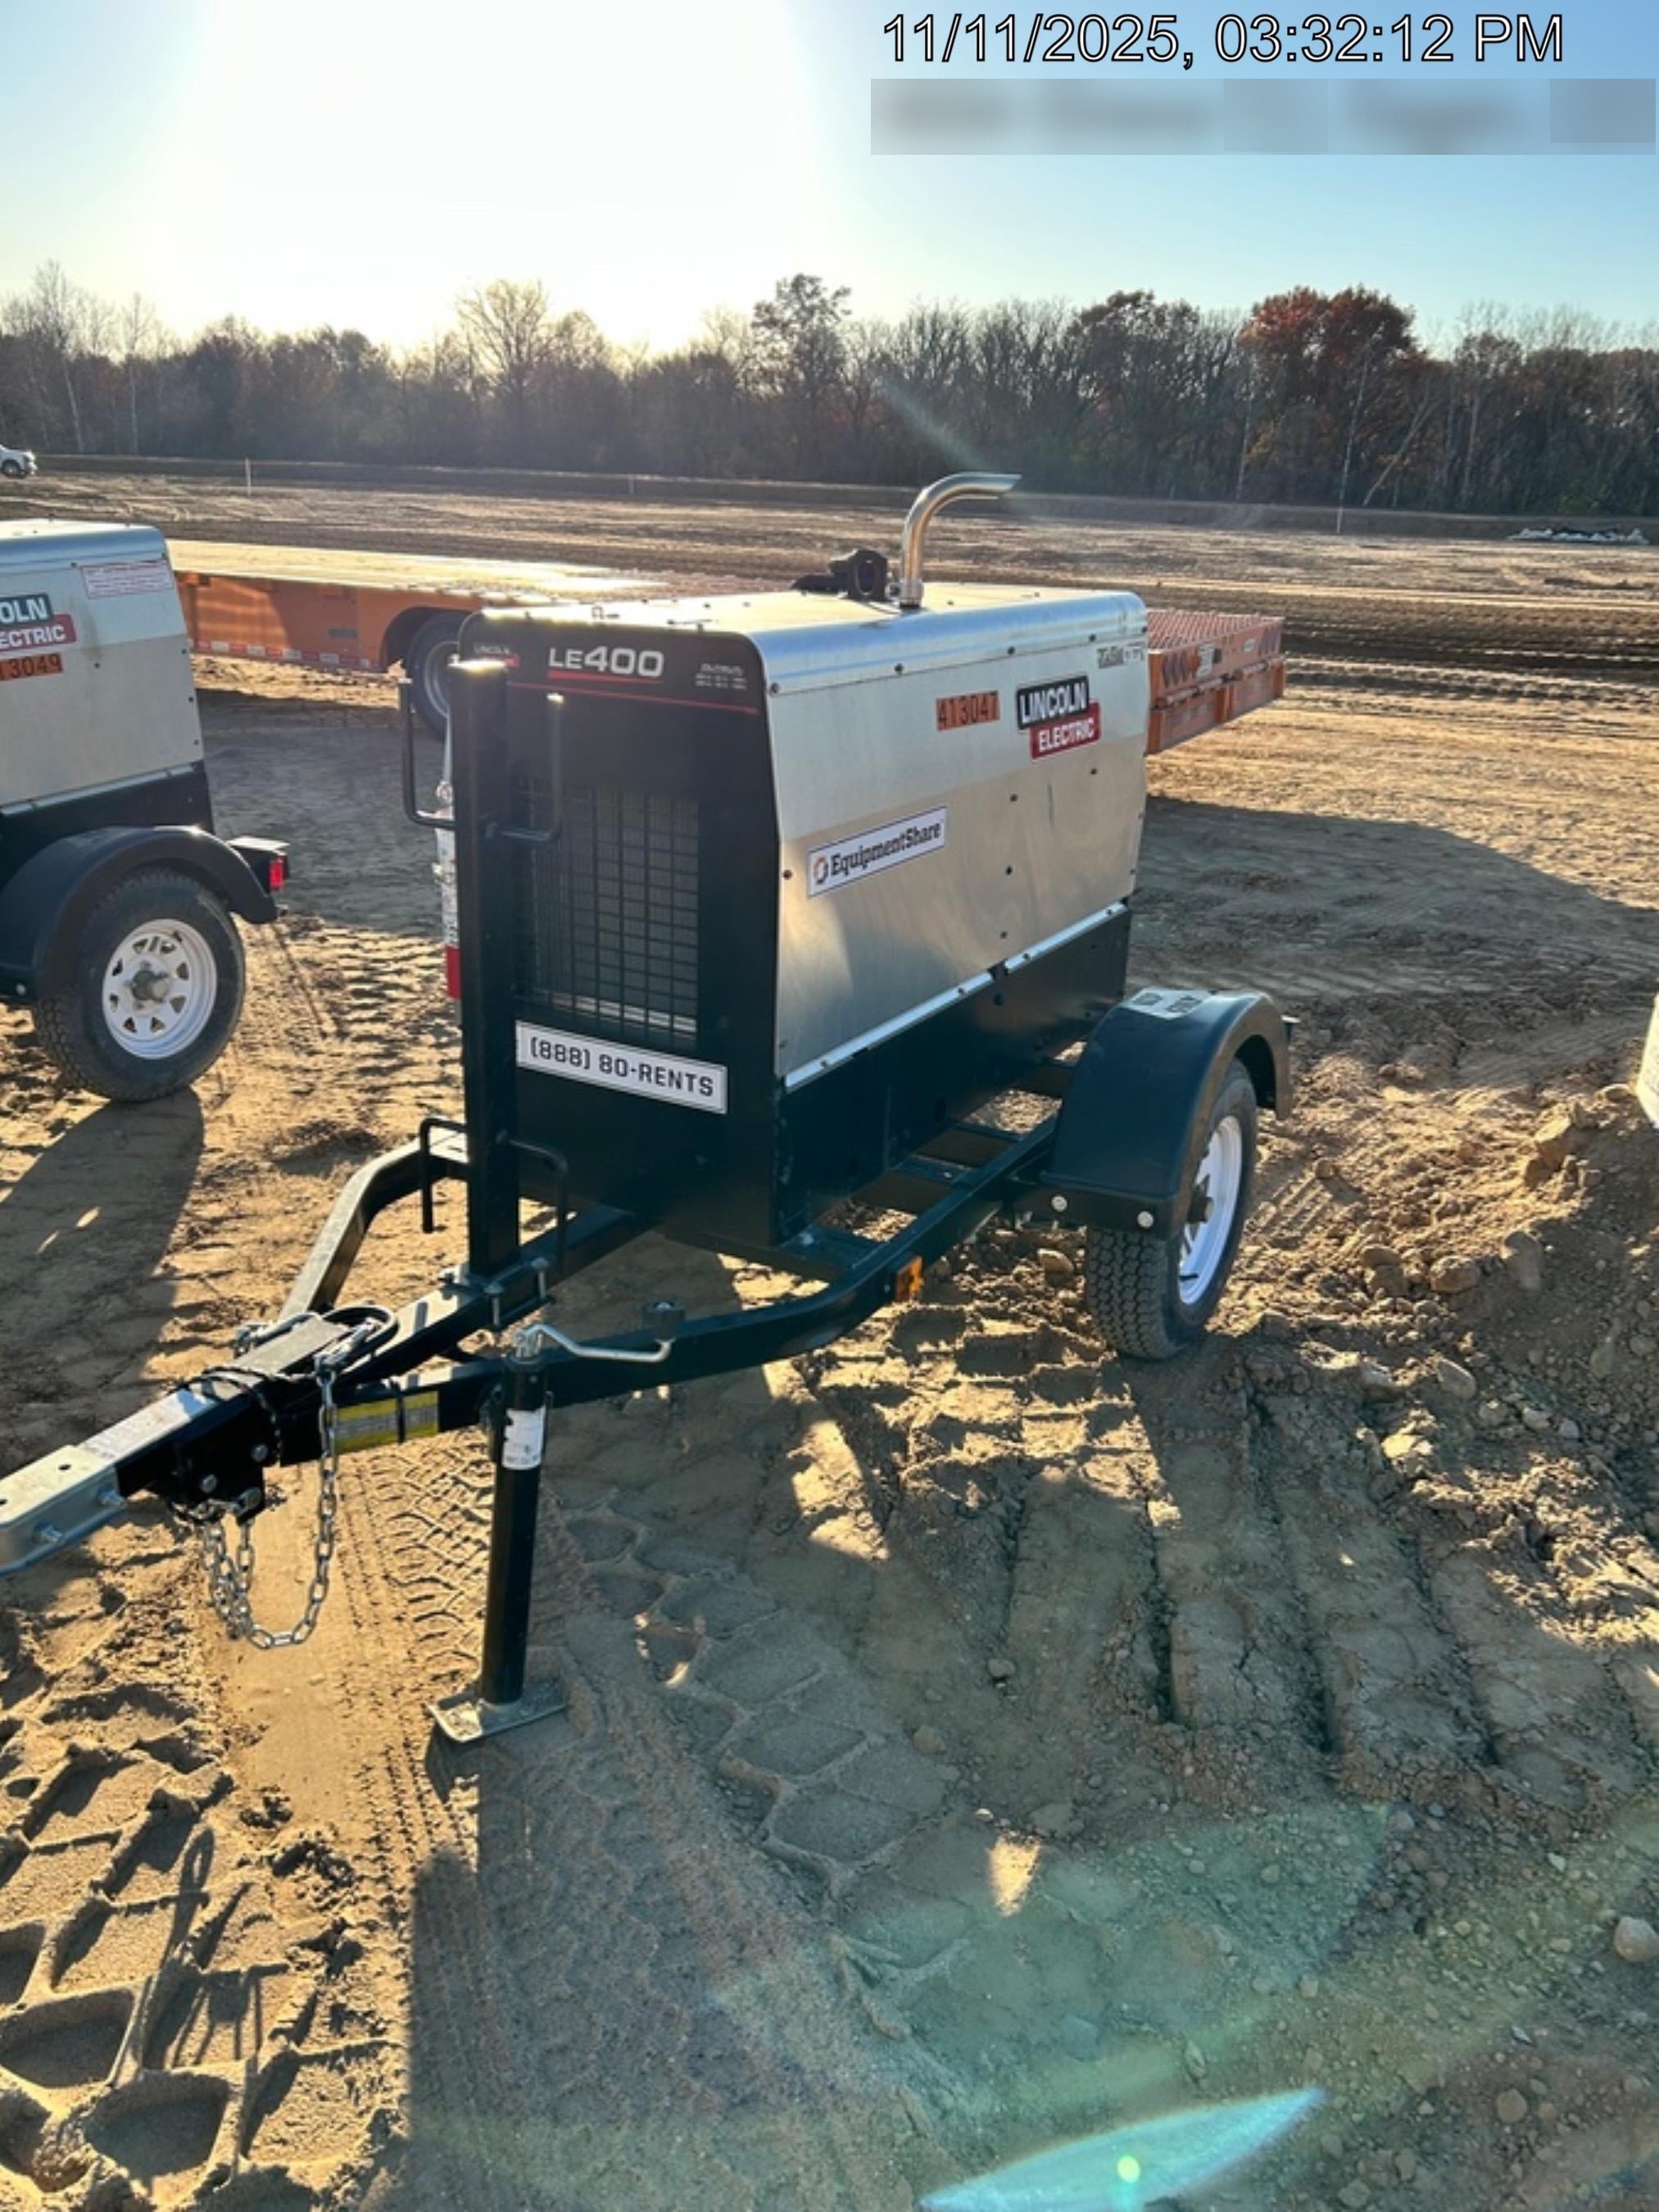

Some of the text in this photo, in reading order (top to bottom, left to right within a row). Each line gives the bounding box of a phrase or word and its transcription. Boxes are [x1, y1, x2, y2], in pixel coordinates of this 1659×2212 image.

[549, 645, 664, 678] LE400
[936, 691, 999, 732] 413047
[1019, 682, 1087, 723] LINCOLN
[1038, 718, 1095, 751] ELECTRIC
[830, 823, 941, 877] EquipmentShare
[530, 1036, 714, 1097] (888) 80-RENTS
